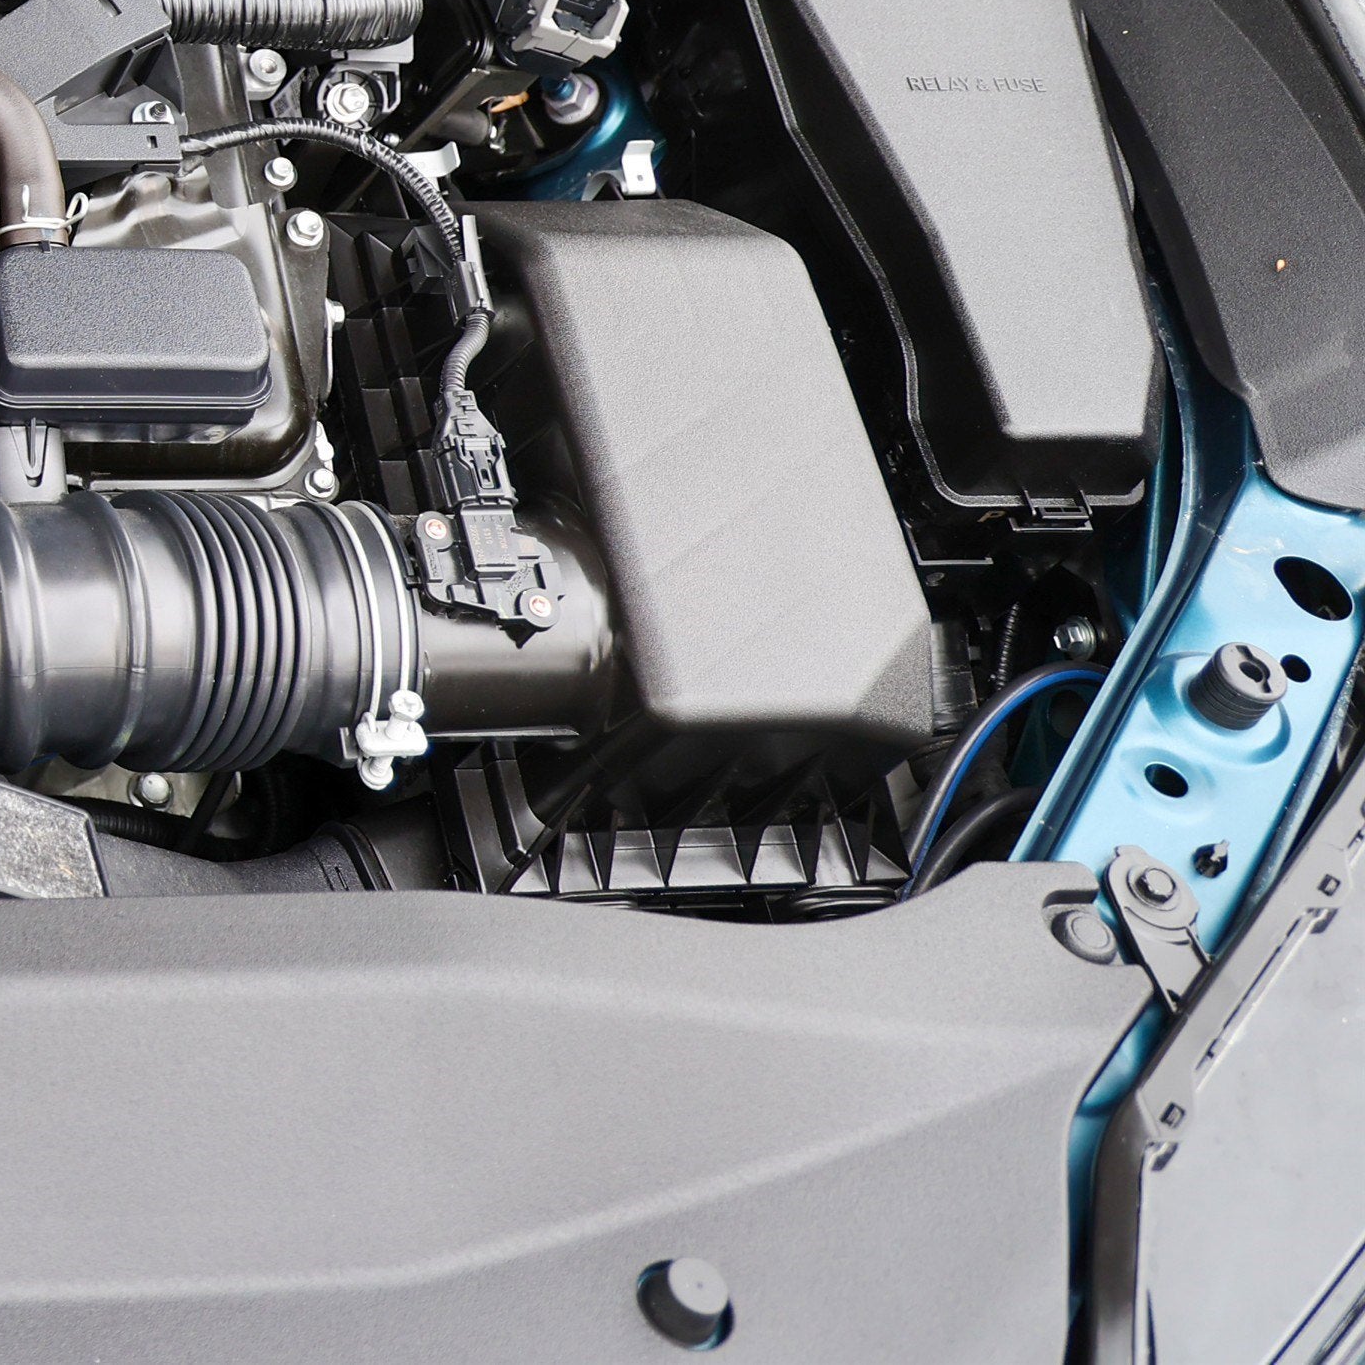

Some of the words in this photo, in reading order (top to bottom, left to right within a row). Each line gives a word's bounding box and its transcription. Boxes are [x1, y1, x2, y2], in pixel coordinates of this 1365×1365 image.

[905, 75, 970, 92] RELAY
[976, 77, 990, 92] &
[993, 76, 1047, 93] FUSE
